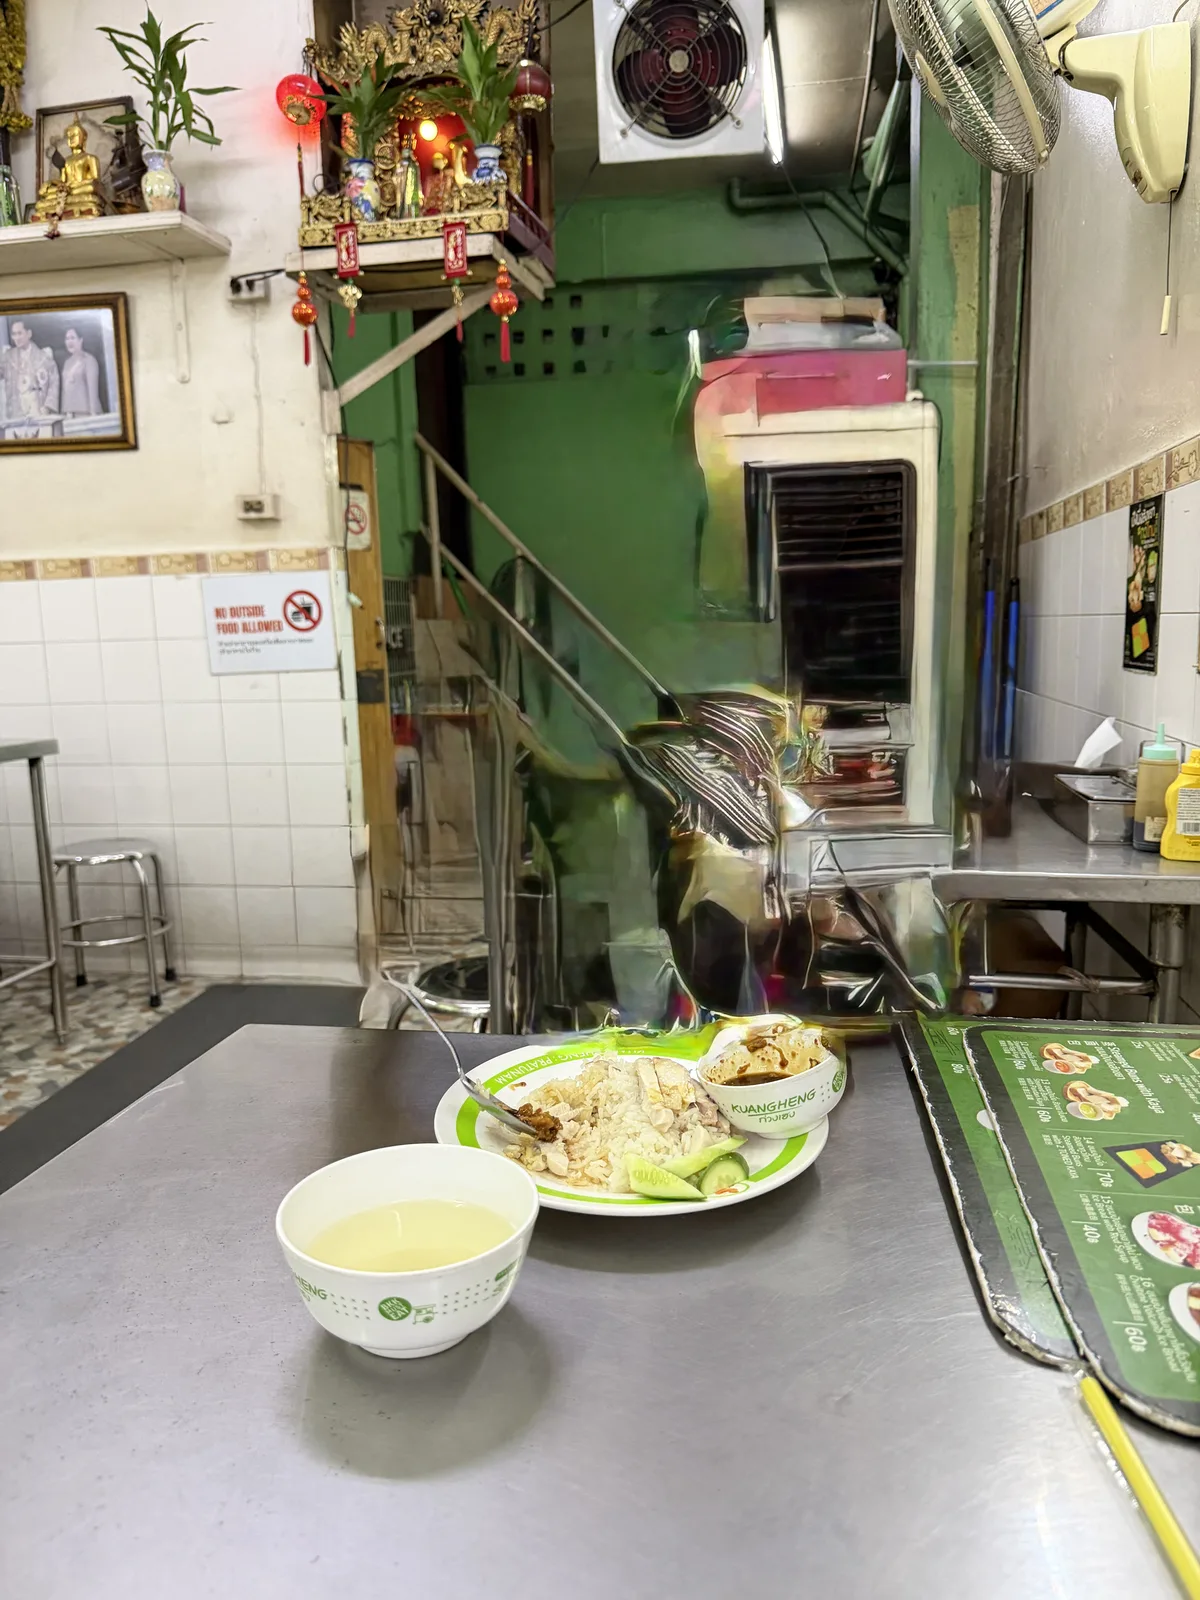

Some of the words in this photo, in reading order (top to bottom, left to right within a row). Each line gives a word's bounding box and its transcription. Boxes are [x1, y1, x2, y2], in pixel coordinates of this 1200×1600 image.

[215, 607, 228, 619] NO
[229, 605, 265, 618] OUTSIDE
[216, 622, 239, 635] FOOD
[241, 620, 284, 633] ALLOWED
[494, 1057, 554, 1085] PRATUNAM
[1108, 1046, 1135, 1069] Steamed
[1124, 1068, 1143, 1083] Buns
[1136, 1083, 1154, 1097] with
[1145, 1097, 1165, 1113] Kaya
[731, 1088, 817, 1114] KUANGHENG
[1083, 1136, 1095, 1144] 14
[1062, 1135, 1079, 1155] Steamed
[1071, 1154, 1083, 1167] Buns
[1059, 1148, 1073, 1166] TONED
[1066, 1165, 1079, 1179] KAYA
[1091, 1194, 1100, 1202] Ice
[1100, 1195, 1114, 1204] 15
[1095, 1202, 1111, 1219] Bread
[1103, 1218, 1115, 1232] with
[1109, 1231, 1122, 1244] Red
[1114, 1244, 1130, 1264] Syrup
[1139, 1276, 1155, 1288] 16
[389, 1306, 410, 1320] EAT
[1155, 1334, 1168, 1347] Ice
[1162, 1347, 1182, 1373] Bread
